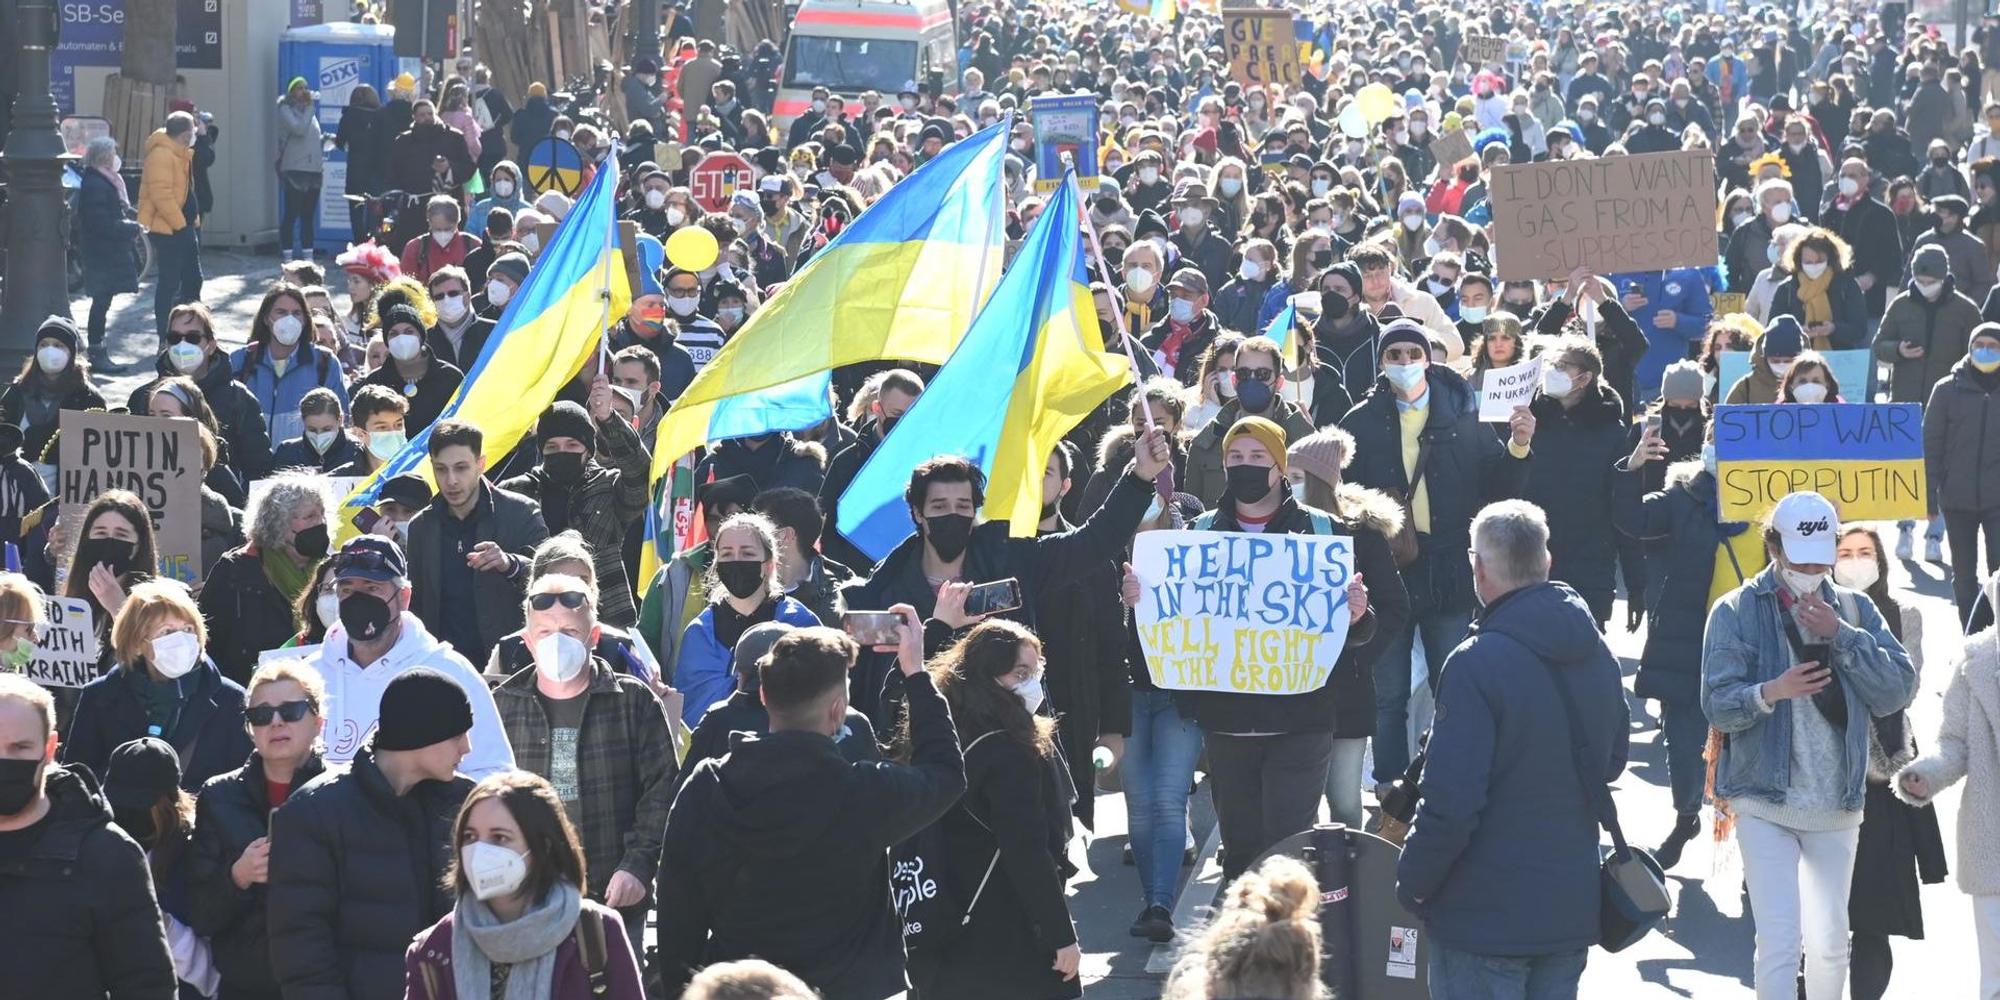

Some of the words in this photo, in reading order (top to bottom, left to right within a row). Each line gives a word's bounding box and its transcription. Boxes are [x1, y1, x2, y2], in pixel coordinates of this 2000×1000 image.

[320, 62, 358, 86] DIXI
[1505, 170, 1524, 201] I
[1536, 162, 1614, 200] DONT
[1629, 155, 1712, 192] WANT
[1516, 201, 1578, 238] GAS
[1594, 197, 1669, 230] FROM
[1680, 194, 1700, 222] A
[1543, 228, 1713, 272] SUPPRESSOR
[1489, 391, 1502, 400] IN
[1498, 376, 1516, 387] NO
[1721, 408, 1820, 442] STOP
[1832, 407, 1915, 444] WAR
[82, 428, 185, 478] PUTIN,
[1725, 468, 1809, 506] STOP
[1815, 467, 1919, 503] PUTIN
[1165, 537, 1273, 584] HELP
[1285, 537, 1350, 587] US
[1151, 581, 1185, 622] IN
[1193, 580, 1250, 622] THE
[1256, 580, 1350, 633] SKY
[1234, 628, 1323, 664] FIGHT
[19, 659, 97, 686] KRAINE
[1172, 656, 1218, 687] THE
[1229, 662, 1328, 693] GROUND
